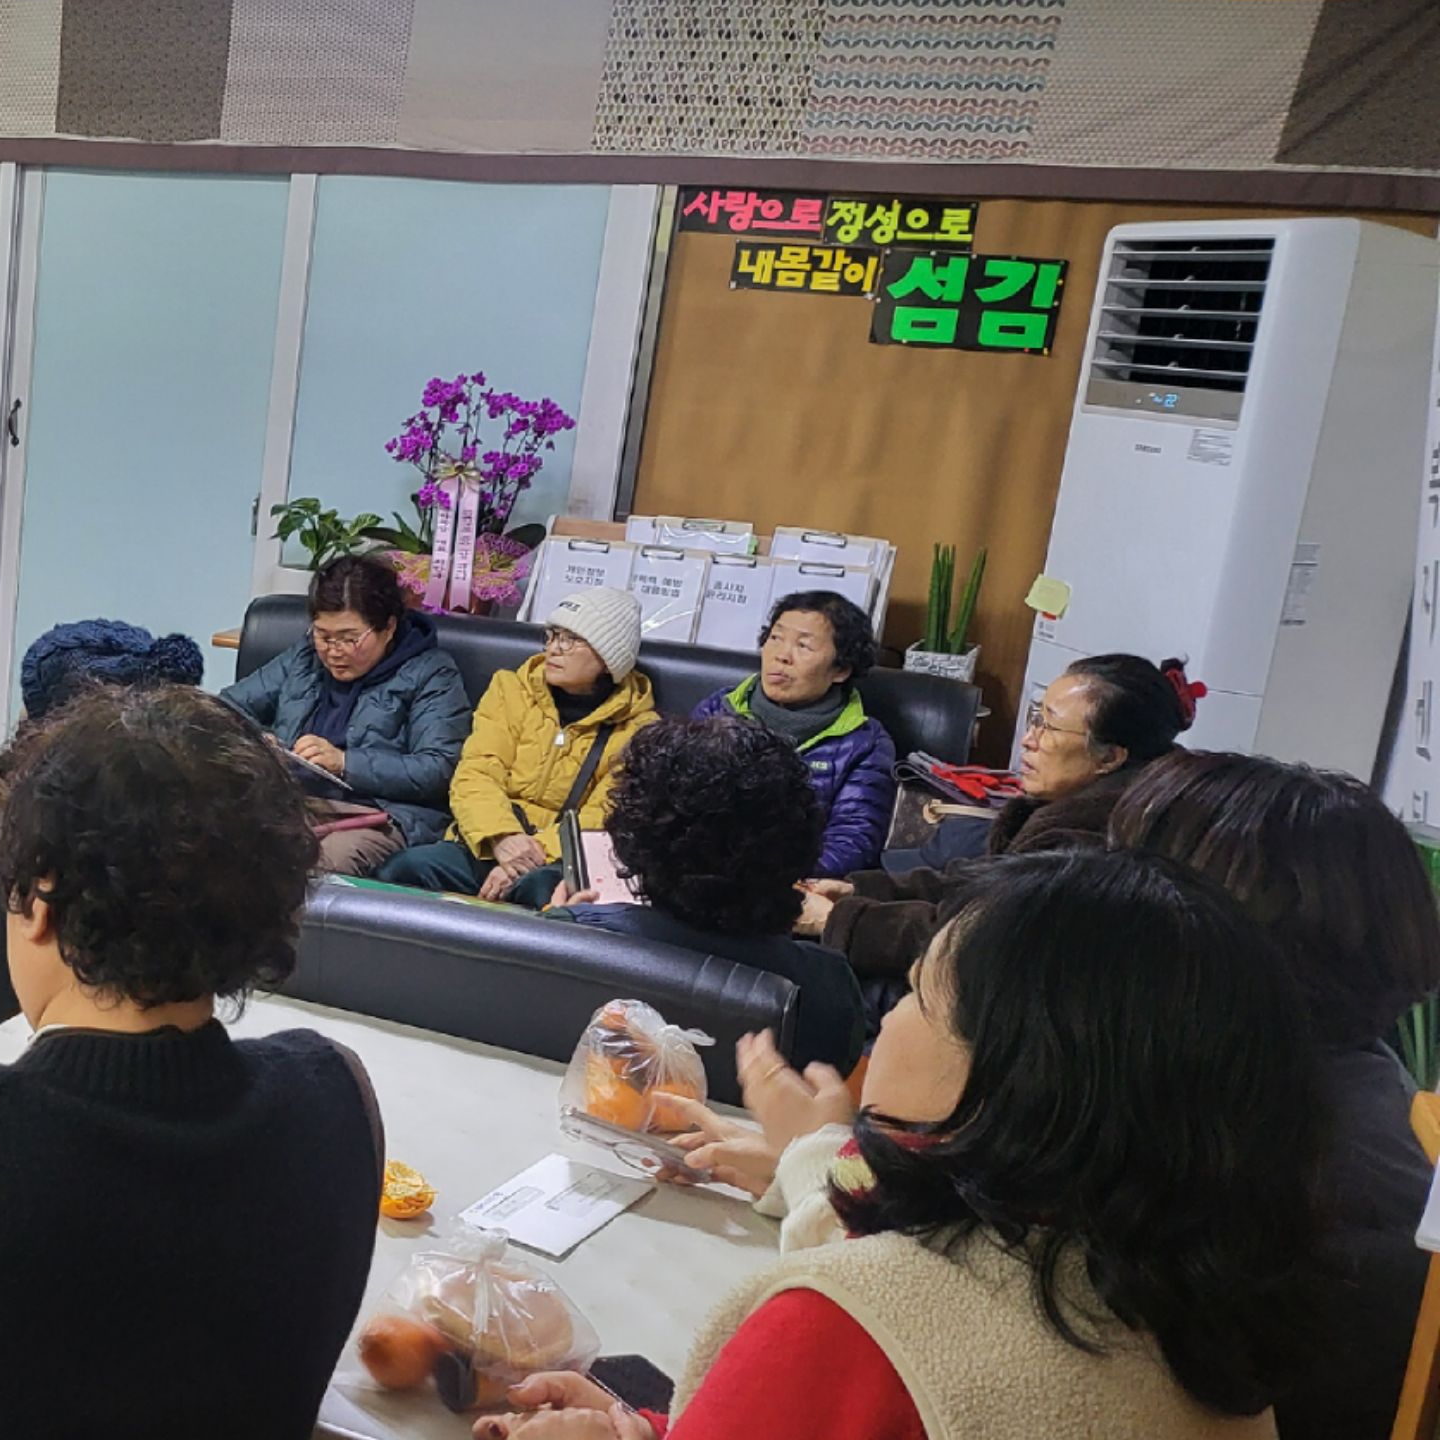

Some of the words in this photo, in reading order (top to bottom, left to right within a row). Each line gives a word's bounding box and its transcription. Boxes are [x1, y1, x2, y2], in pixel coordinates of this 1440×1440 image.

[683, 190, 823, 232] 사랑으로
[825, 199, 973, 244] 정성으로
[738, 246, 878, 292] 내몸같이
[886, 256, 1061, 348] 섬김
